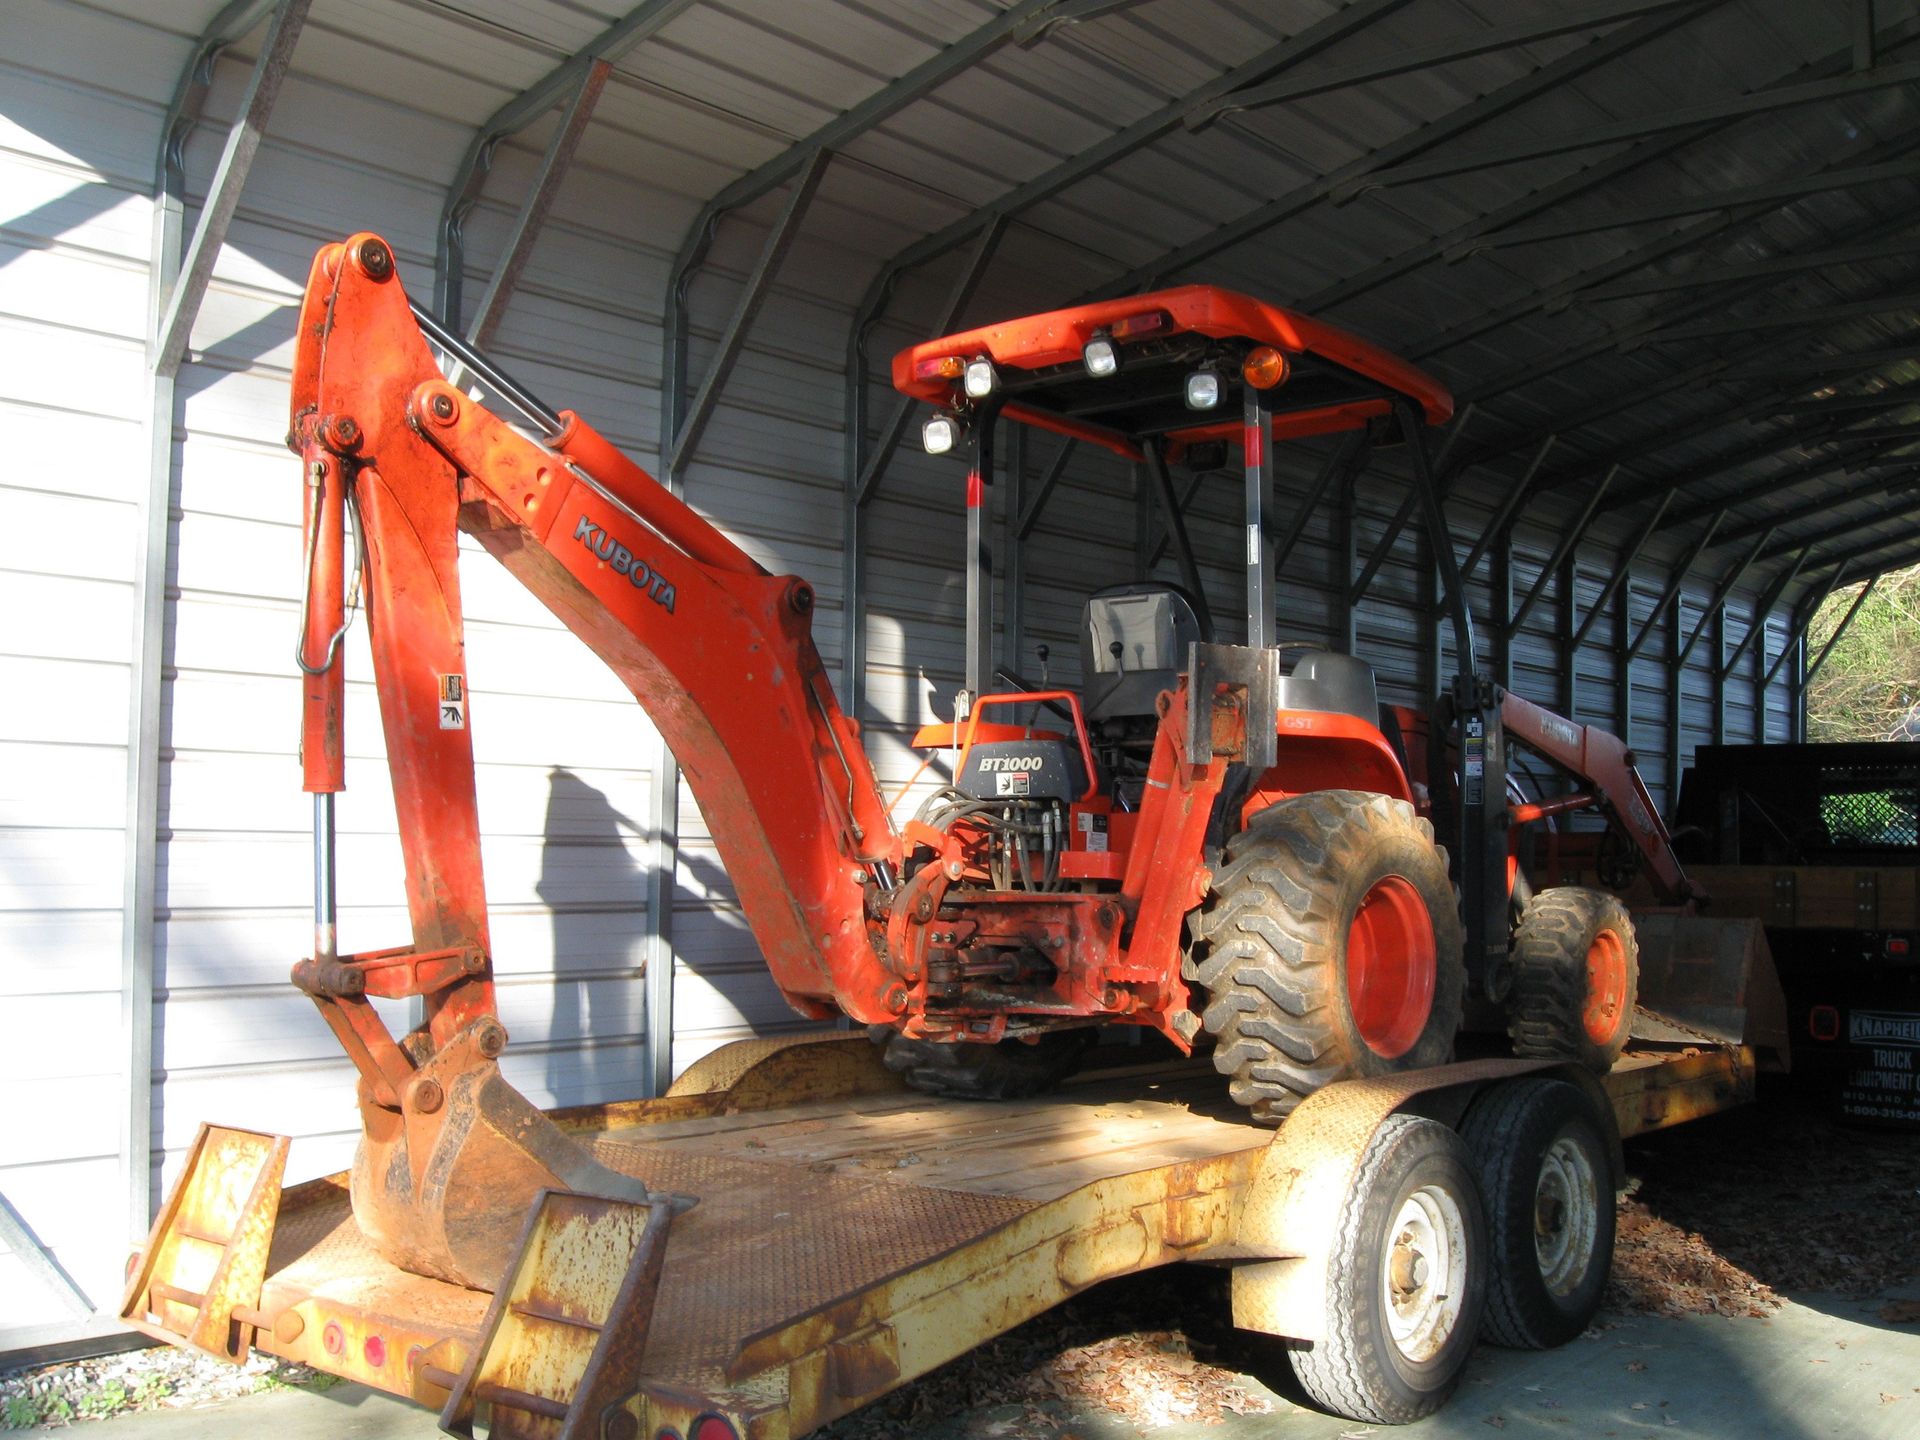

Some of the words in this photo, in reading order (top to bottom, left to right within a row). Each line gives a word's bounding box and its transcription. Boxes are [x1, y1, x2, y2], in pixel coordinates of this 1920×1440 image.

[573, 514, 676, 615] KUBOTA
[1284, 717, 1312, 730] GST
[979, 756, 1043, 772] BT1000
[1873, 1049, 1912, 1069] TRUCK
[1848, 1068, 1914, 1090] EQUIPMENT
